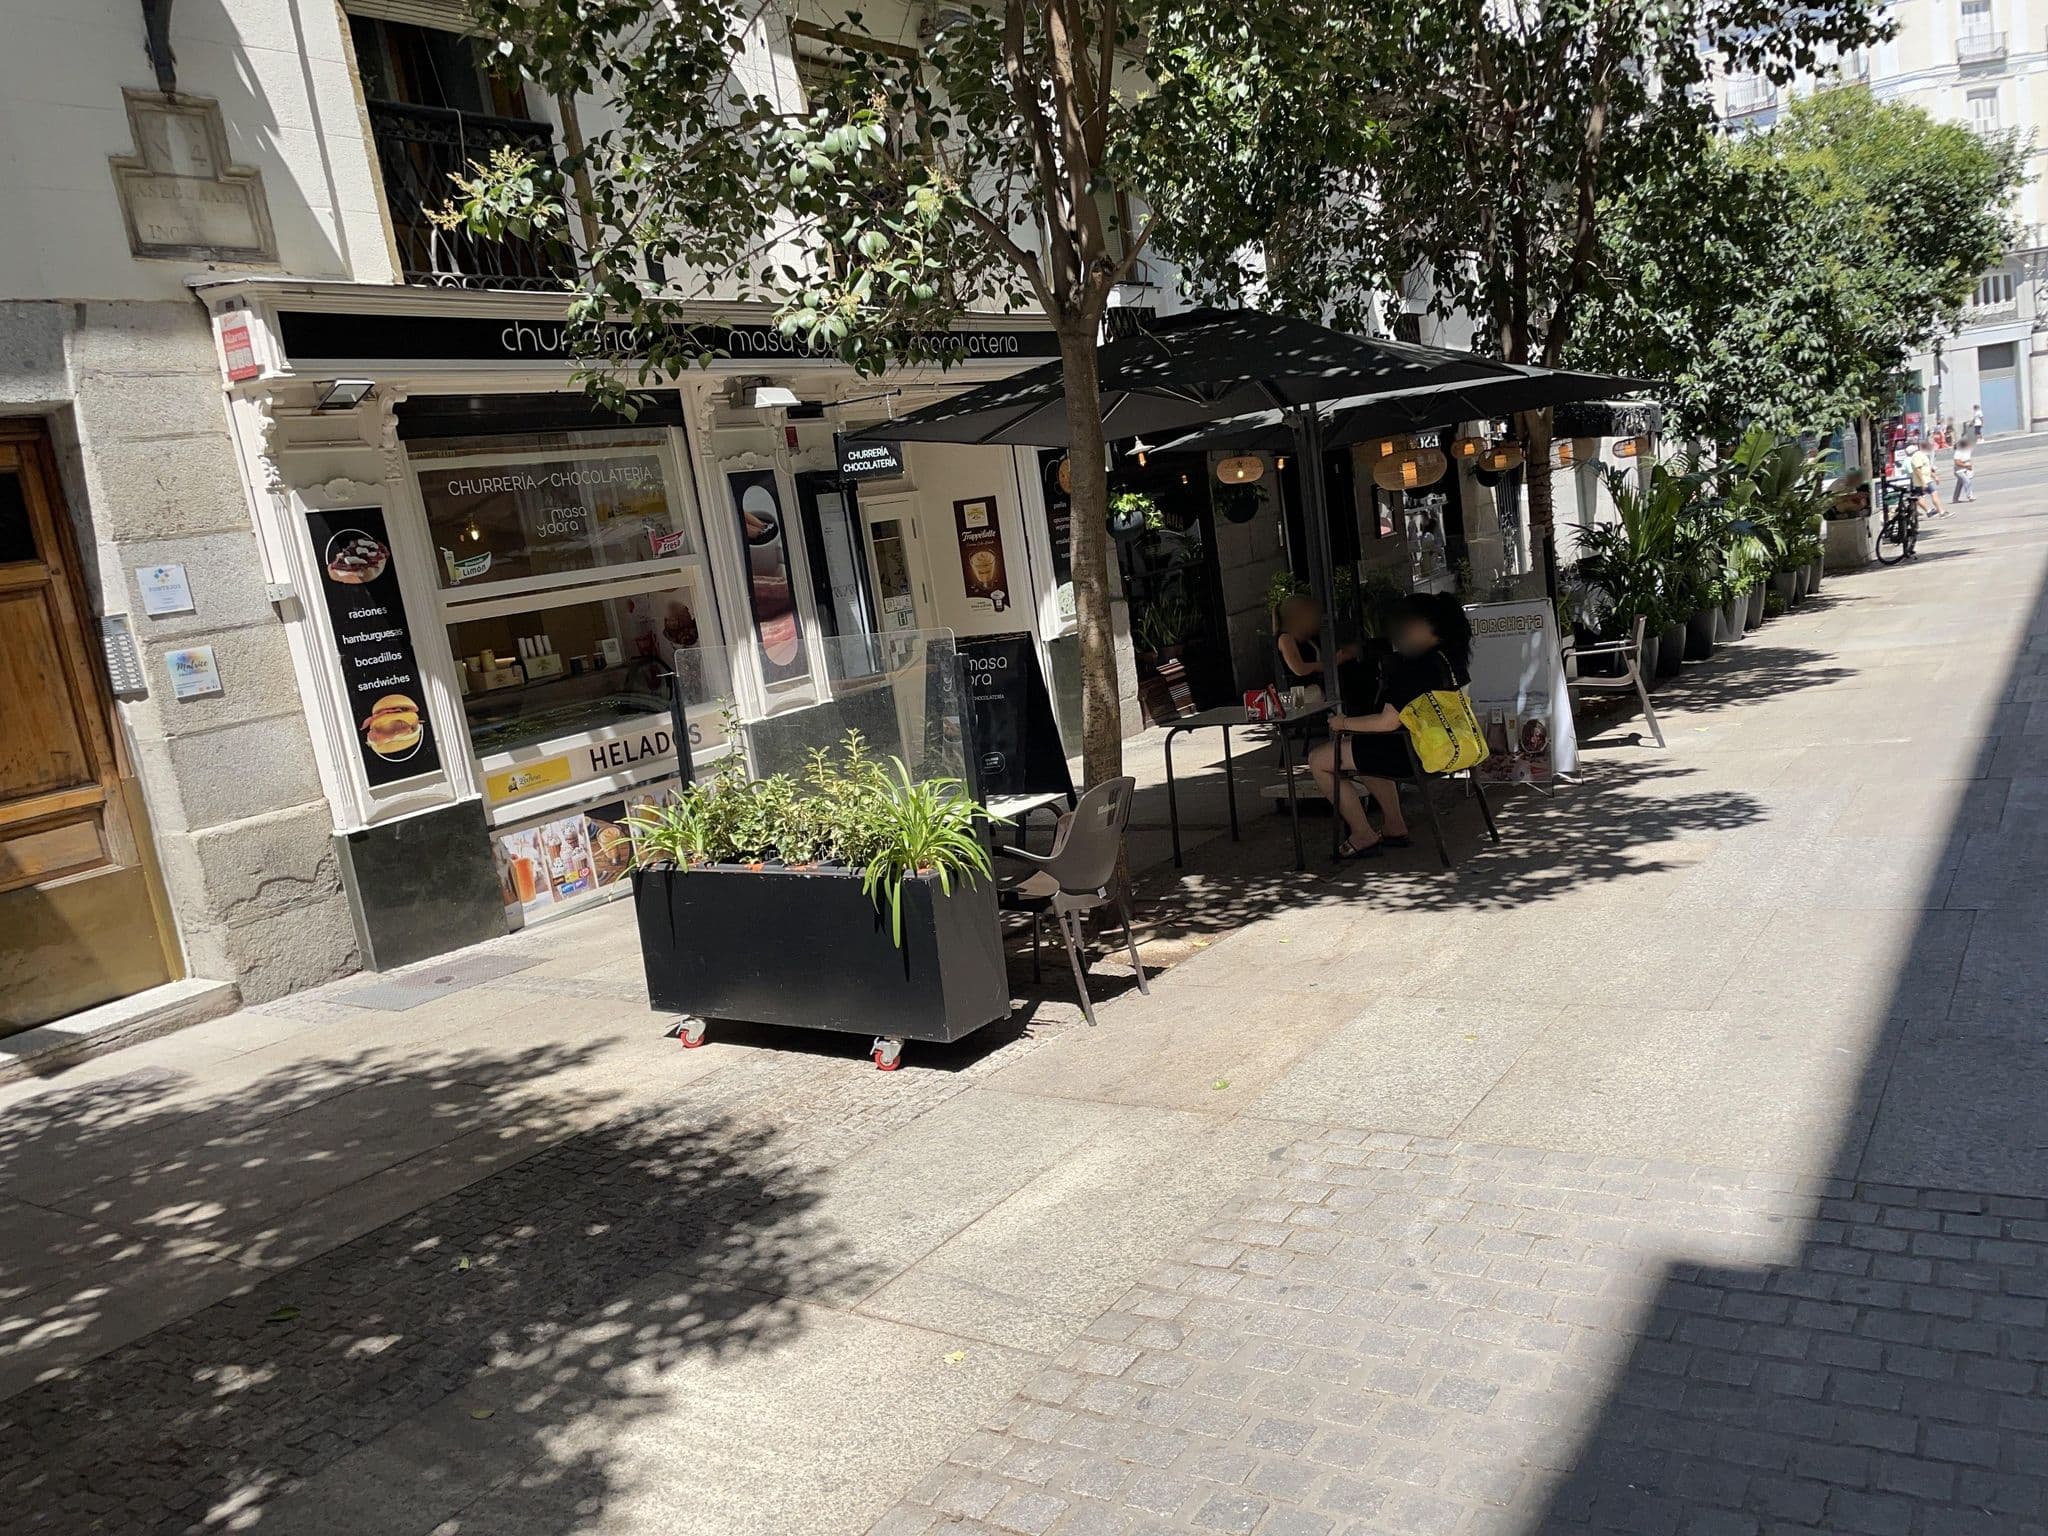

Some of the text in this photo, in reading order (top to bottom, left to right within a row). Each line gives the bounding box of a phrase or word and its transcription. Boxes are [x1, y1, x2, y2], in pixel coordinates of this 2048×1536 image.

[848, 445, 889, 461] CHURRERÍA
[842, 456, 898, 473] CHOCOLATERÍA
[550, 505, 588, 519] masa
[663, 539, 682, 551] Fresa
[348, 606, 388, 619] raciones
[342, 628, 404, 645] hamburguesas
[354, 651, 403, 668] bocadillos
[357, 673, 411, 692] sandwiches
[589, 722, 703, 772] HELADS
